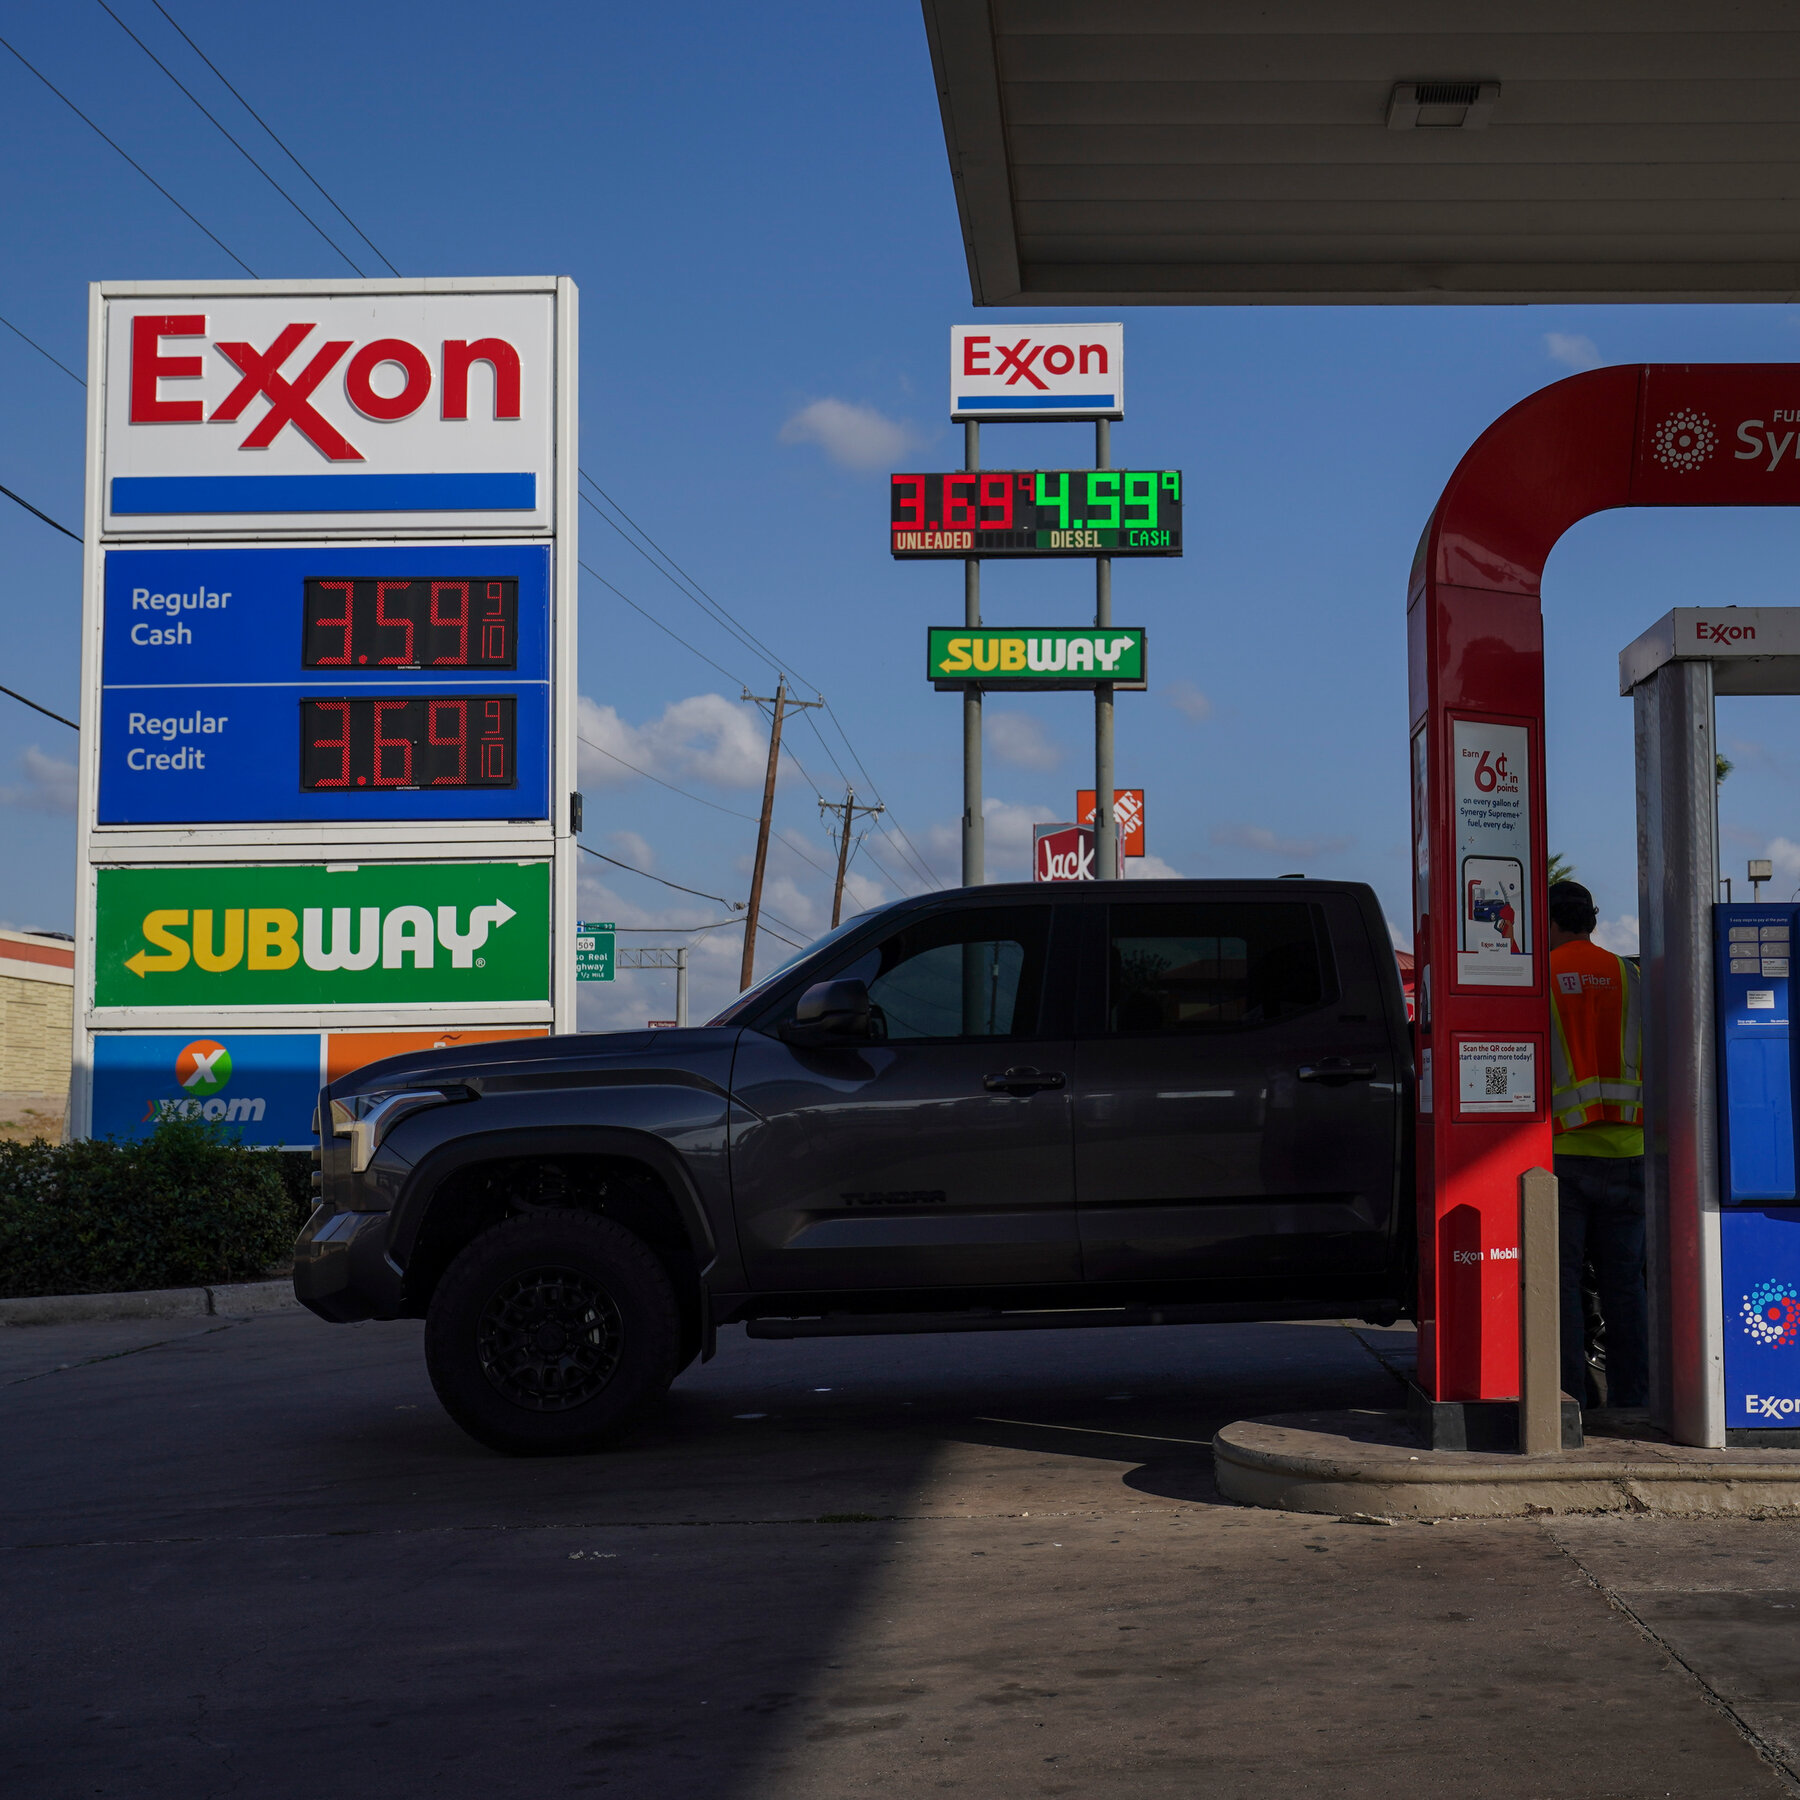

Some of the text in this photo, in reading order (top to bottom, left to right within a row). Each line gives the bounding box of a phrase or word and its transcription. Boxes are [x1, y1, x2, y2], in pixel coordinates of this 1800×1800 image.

[963, 336, 1109, 390] Exxon
[129, 314, 522, 463] Exxon
[1734, 419, 1800, 472] Sy
[1036, 472, 1158, 529] 4.59
[897, 531, 972, 550] UNLEADED
[1050, 530, 1170, 548] DIESEL CASH
[132, 586, 232, 616] Regular
[130, 622, 192, 646] Cash
[316, 581, 469, 665] 3.59
[1696, 622, 1756, 645] Exxon
[938, 635, 1135, 674] SUBWAY
[128, 710, 228, 740] Regular
[313, 700, 467, 787] 3.69
[126, 746, 206, 771] Credit
[1462, 749, 1480, 758] Earn
[1510, 772, 1518, 783] in
[1496, 784, 1518, 793] points
[1460, 807, 1487, 818] Synergy
[1473, 799, 1491, 808] every
[1492, 799, 1511, 808] gallon
[1513, 800, 1520, 808] of
[1467, 819, 1482, 828] fuel,
[1483, 821, 1501, 830] every
[1040, 834, 1095, 882] Jack
[123, 898, 517, 979] SUBWAY
[1762, 929, 1768, 937] 2
[588, 953, 608, 961] Real
[1732, 945, 1738, 953] 3
[1732, 961, 1739, 969] 5
[1581, 974, 1611, 985] Fiber
[1473, 1053, 1496, 1062] earning
[1453, 1247, 1518, 1265] Exxon Mobil
